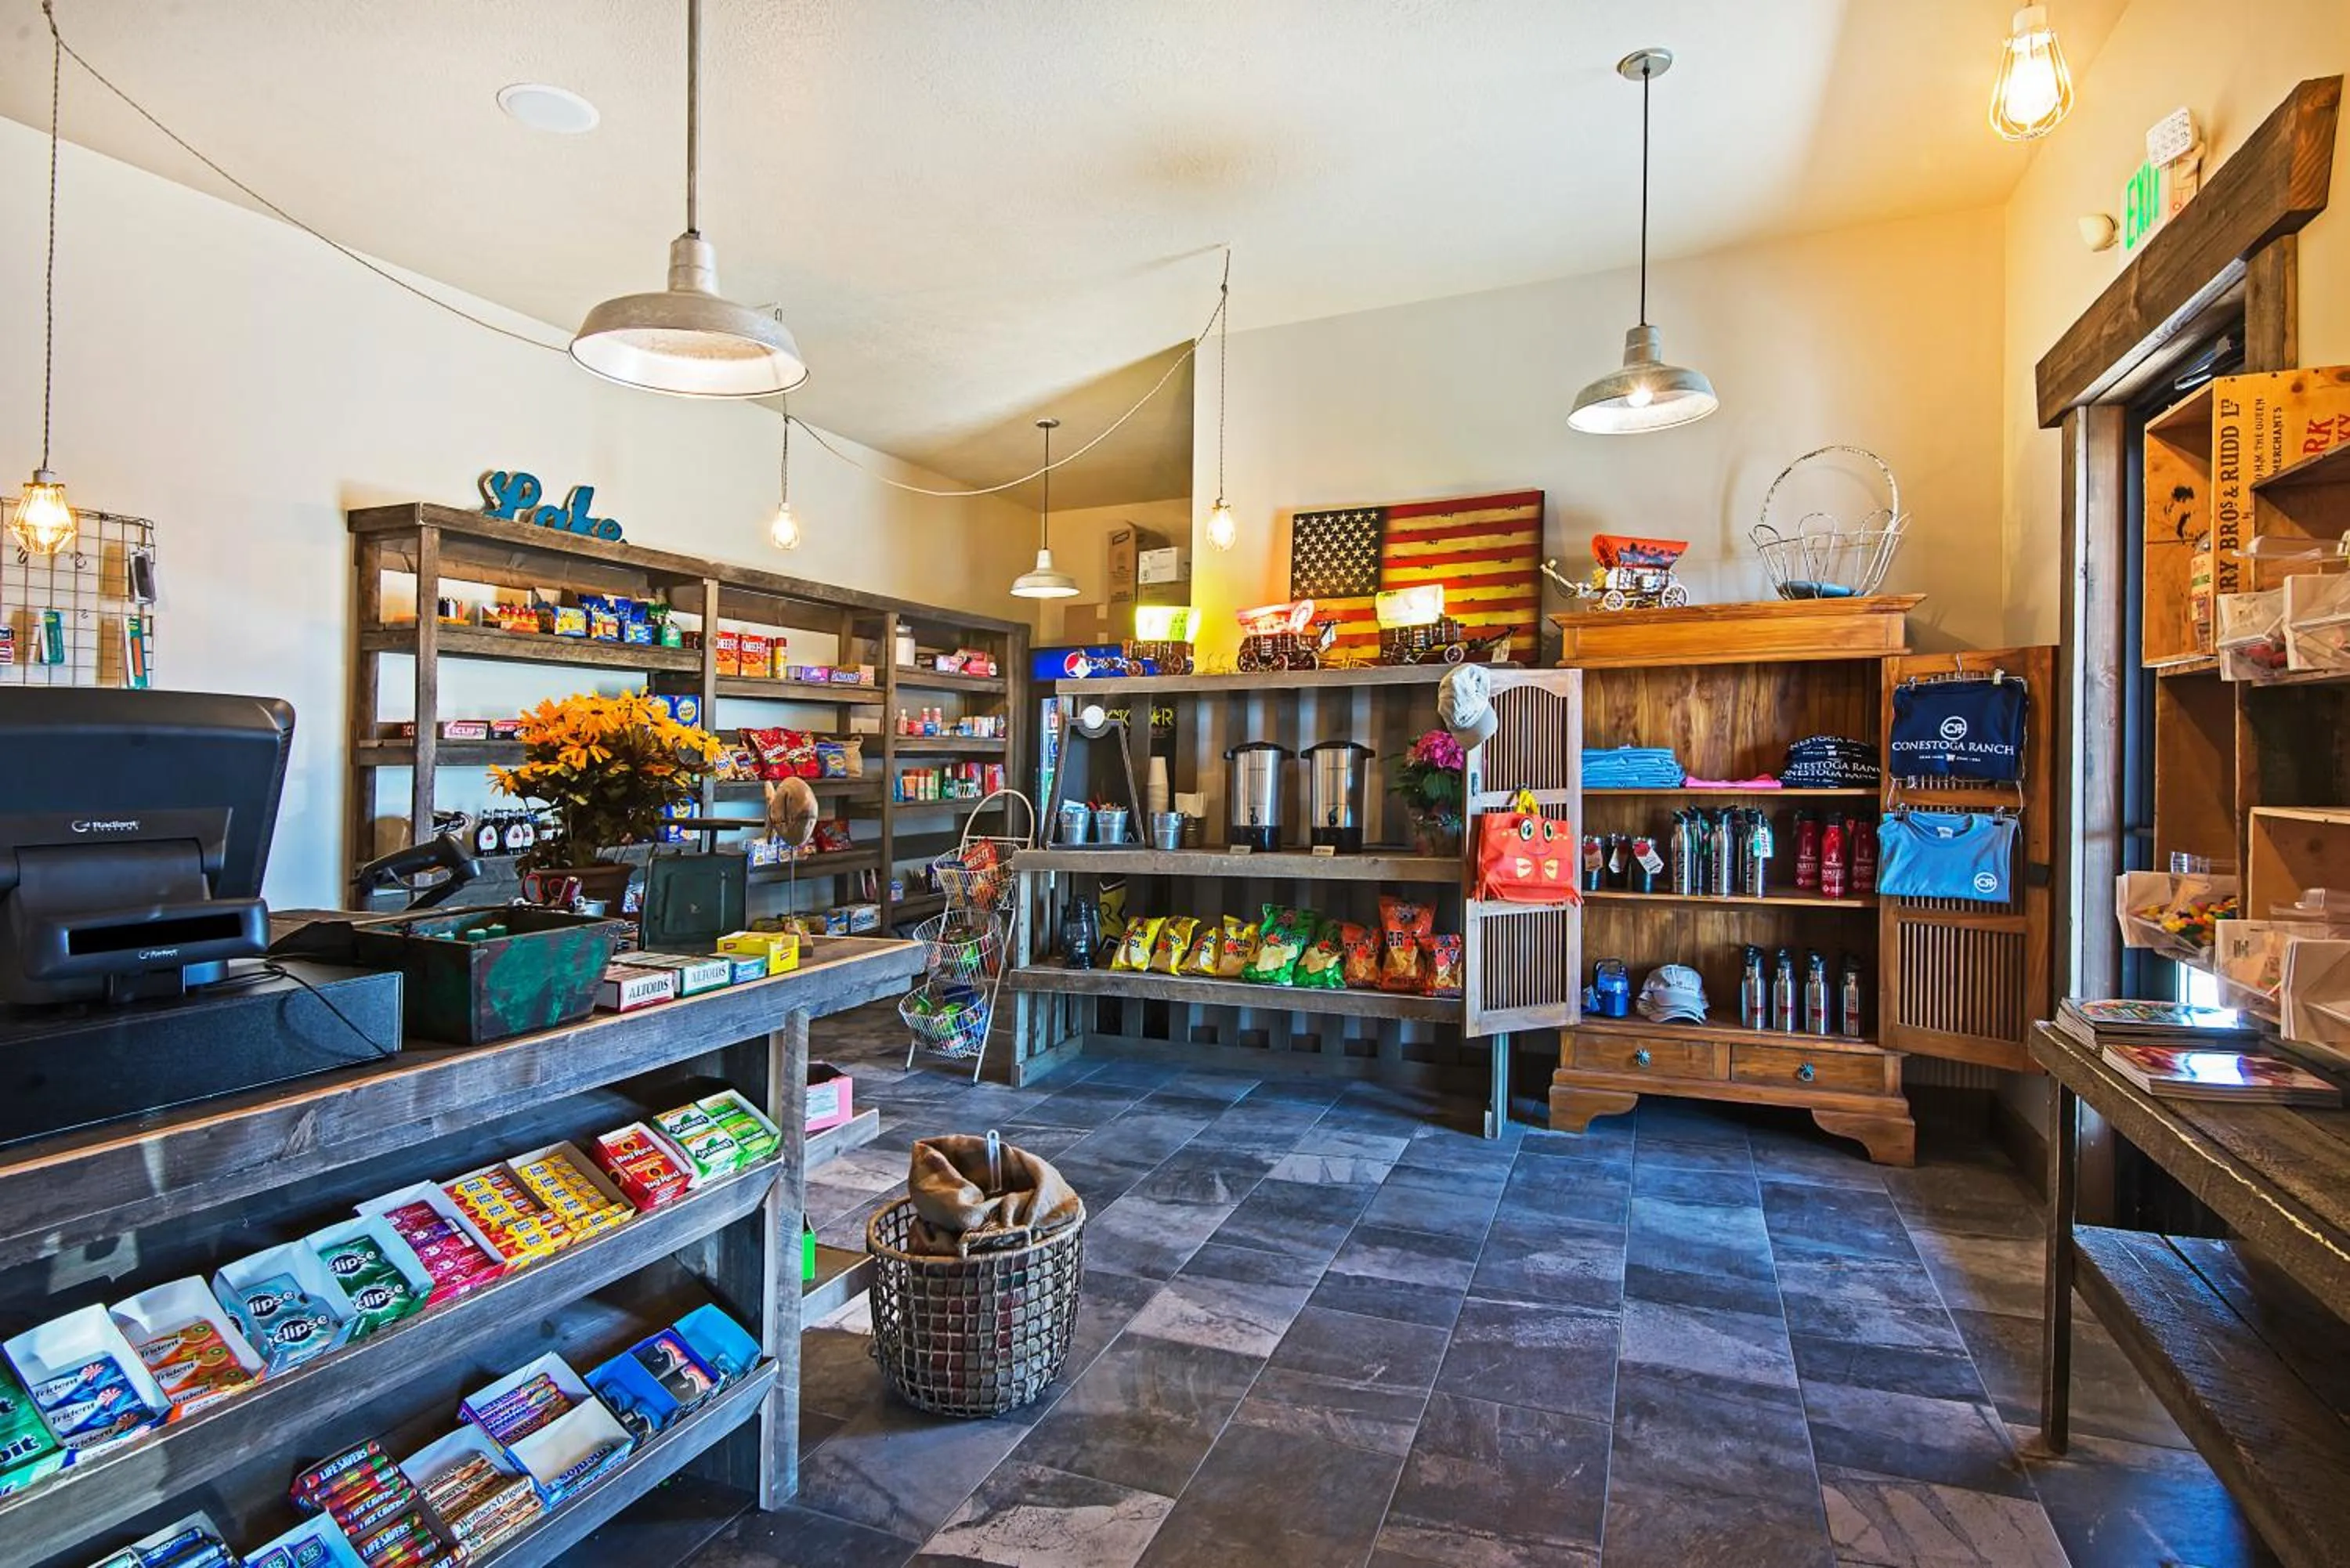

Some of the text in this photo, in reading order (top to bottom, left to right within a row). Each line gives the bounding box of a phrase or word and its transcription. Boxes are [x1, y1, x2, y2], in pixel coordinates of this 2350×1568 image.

[2126, 159, 2160, 251] EXIT
[2303, 418, 2335, 453] RK
[2220, 425, 2240, 482] RUDD
[2223, 486, 2239, 498] &
[1892, 739, 2015, 756] CONESTOGA RANCH
[691, 966, 726, 983] ALTOIDS
[627, 981, 669, 1000] ALTOIDS
[248, 1291, 295, 1314] lipse
[356, 1284, 405, 1311] clipse
[141, 1339, 179, 1358] Trident
[157, 1361, 194, 1381] Trident
[35, 1377, 78, 1398] Trident
[52, 1401, 96, 1425] Trident
[496, 1478, 531, 1503] Original
